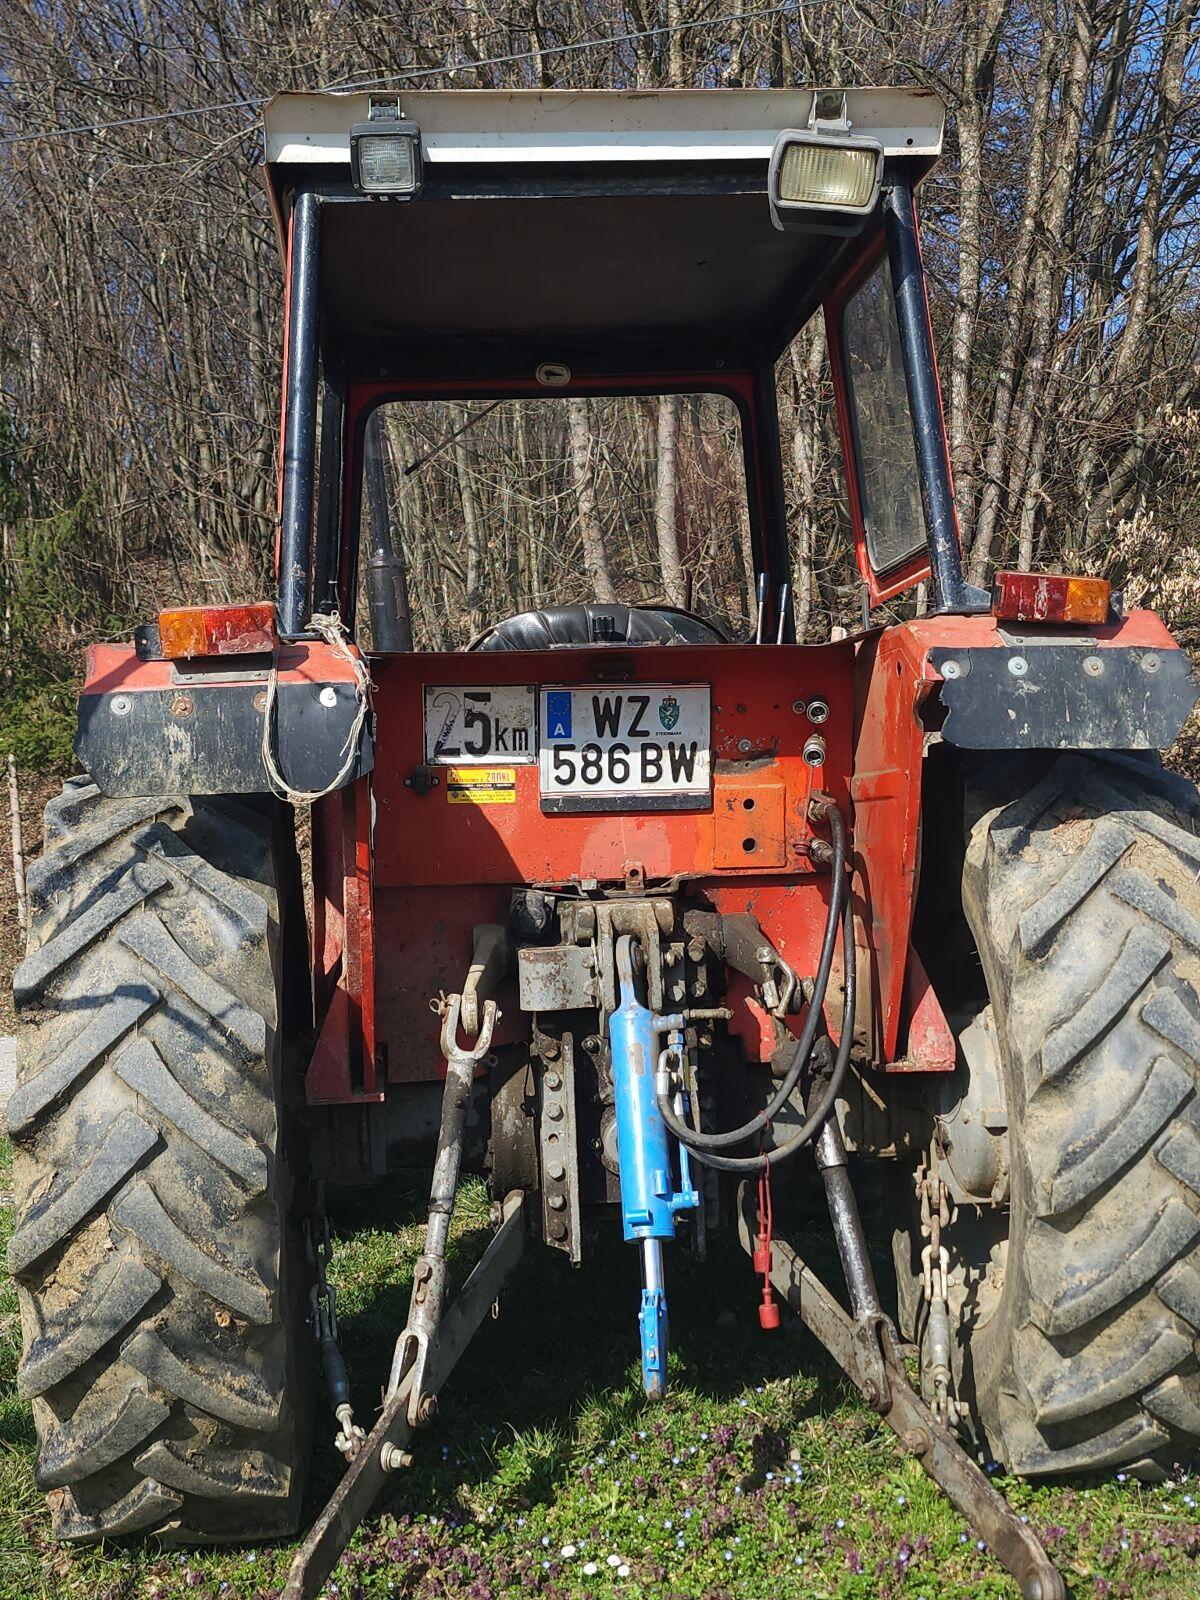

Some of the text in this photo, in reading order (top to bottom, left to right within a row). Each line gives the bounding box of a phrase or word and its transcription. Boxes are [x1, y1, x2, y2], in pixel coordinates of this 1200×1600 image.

[553, 723, 566, 736] A
[592, 695, 650, 738] WZ
[553, 741, 698, 786] 586 BW
